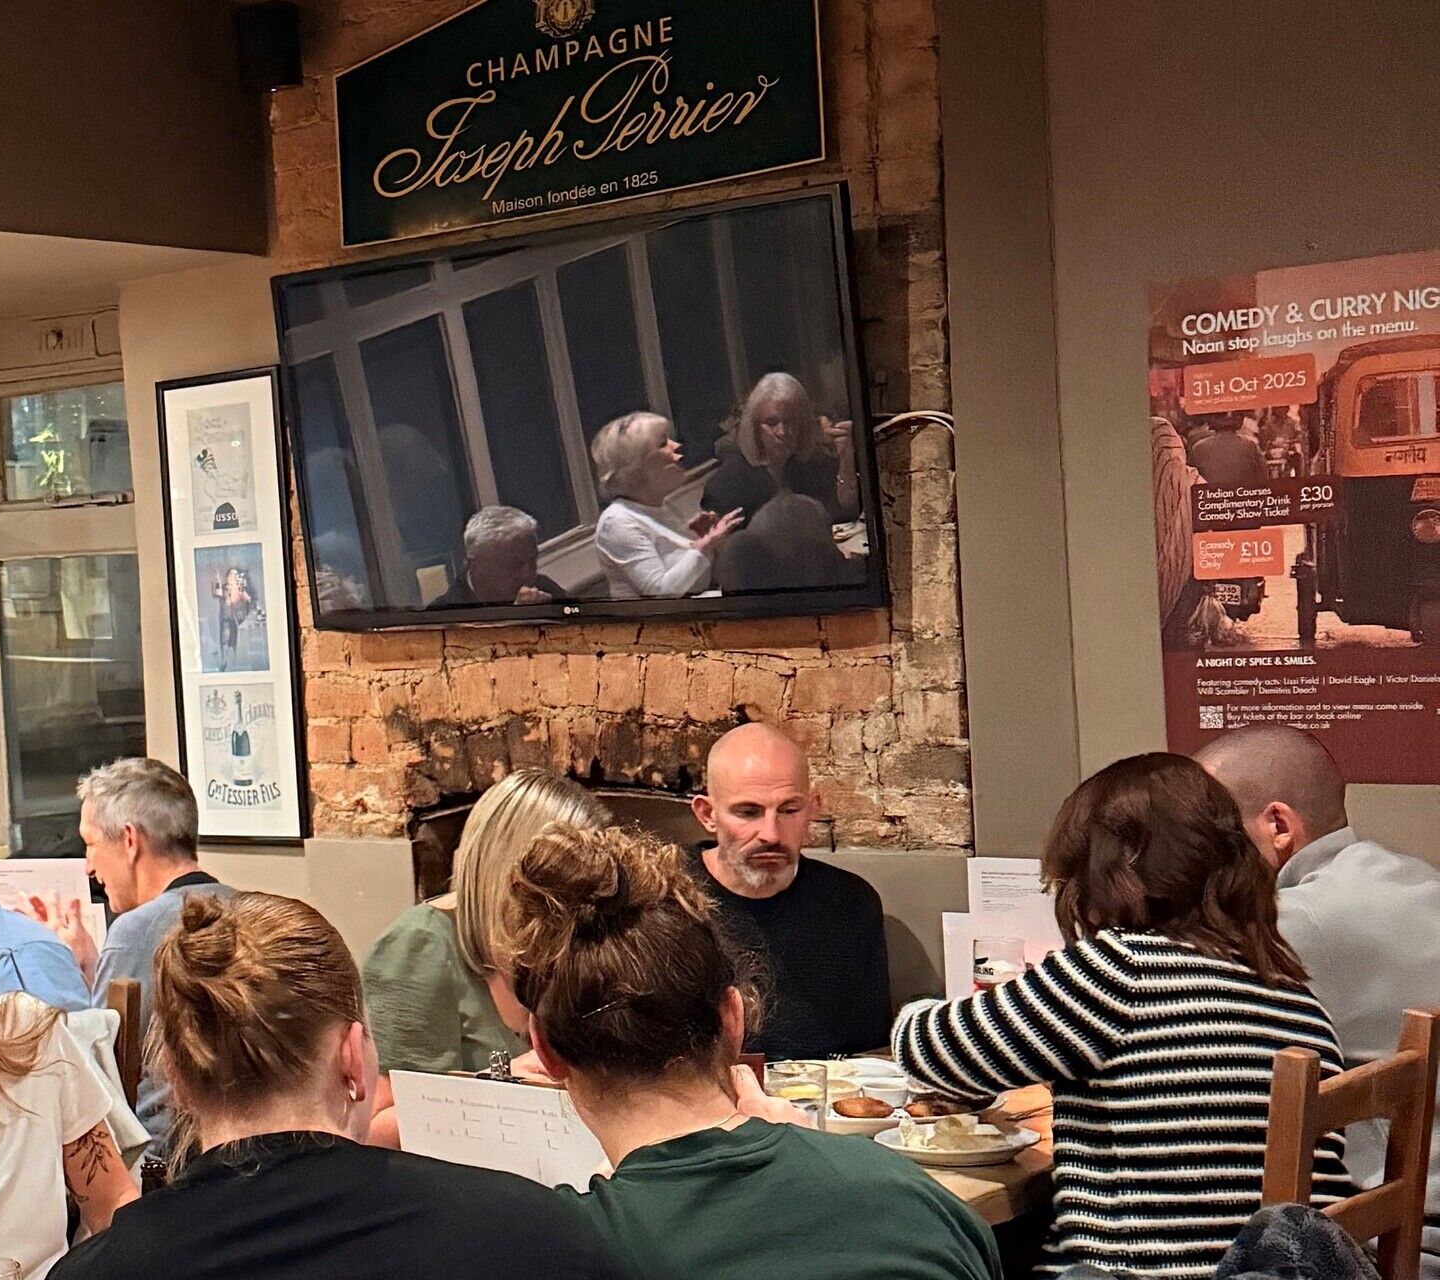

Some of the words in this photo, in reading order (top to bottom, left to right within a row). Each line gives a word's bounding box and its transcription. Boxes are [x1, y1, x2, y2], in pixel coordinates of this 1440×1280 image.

[466, 15, 675, 89] CHAMPAGNE
[372, 89, 579, 201] Joseph
[571, 49, 781, 162] Perrier
[491, 195, 543, 216] Maison
[546, 184, 596, 207] fondée
[598, 182, 619, 196] en
[622, 170, 660, 190] 1825
[1181, 305, 1280, 336] COMEDY
[1285, 303, 1305, 324] &
[1309, 292, 1387, 322] CURRY
[1182, 337, 1225, 356] Naan
[1228, 336, 1260, 353] stop
[1262, 328, 1313, 349] laughs
[1316, 326, 1337, 340] on
[1342, 320, 1366, 337] the
[1369, 319, 1419, 336] menu.
[1192, 380, 1225, 397] 31st
[1229, 377, 1260, 394] Oct
[1263, 370, 1307, 390] 2025
[1197, 490, 1205, 500] 2
[1206, 489, 1234, 499] Indian
[1236, 487, 1272, 497] Courses
[1299, 485, 1333, 502] £30
[1198, 498, 1265, 512] Complimentary
[1266, 494, 1291, 505] Drink
[1199, 510, 1236, 522] Comedy
[1236, 508, 1262, 519] Show
[1264, 507, 1290, 517] Ticket
[1199, 539, 1235, 552] Comedy
[1241, 541, 1272, 557] £10
[1199, 549, 1225, 560] Show
[1199, 559, 1222, 570] Only
[1196, 658, 1205, 668] A
[1206, 657, 1233, 667] NIGHT
[1234, 657, 1247, 667] OF
[1249, 656, 1272, 666] SPICE
[1274, 656, 1282, 666] &
[1284, 655, 1317, 666] SMILES.
[1197, 678, 1232, 688] Featuring
[1233, 677, 1263, 687] comedy
[1328, 676, 1353, 685] David
[1353, 675, 1377, 687] Eagle
[1385, 674, 1409, 684] Victor
[1197, 686, 1214, 696] Will
[1226, 703, 1238, 712] For
[1240, 704, 1260, 712] more
[1261, 702, 1304, 711] information
[1305, 702, 1321, 711] and
[1322, 703, 1331, 711] to
[1332, 703, 1351, 711] view
[1226, 712, 1241, 722] Buy
[1242, 712, 1265, 721] tickets
[1266, 712, 1275, 721] at
[1276, 711, 1288, 721] the
[1289, 711, 1304, 721] bar
[1315, 711, 1335, 721] book
[222, 783, 261, 807] TESSIER
[259, 781, 281, 804] FILS
